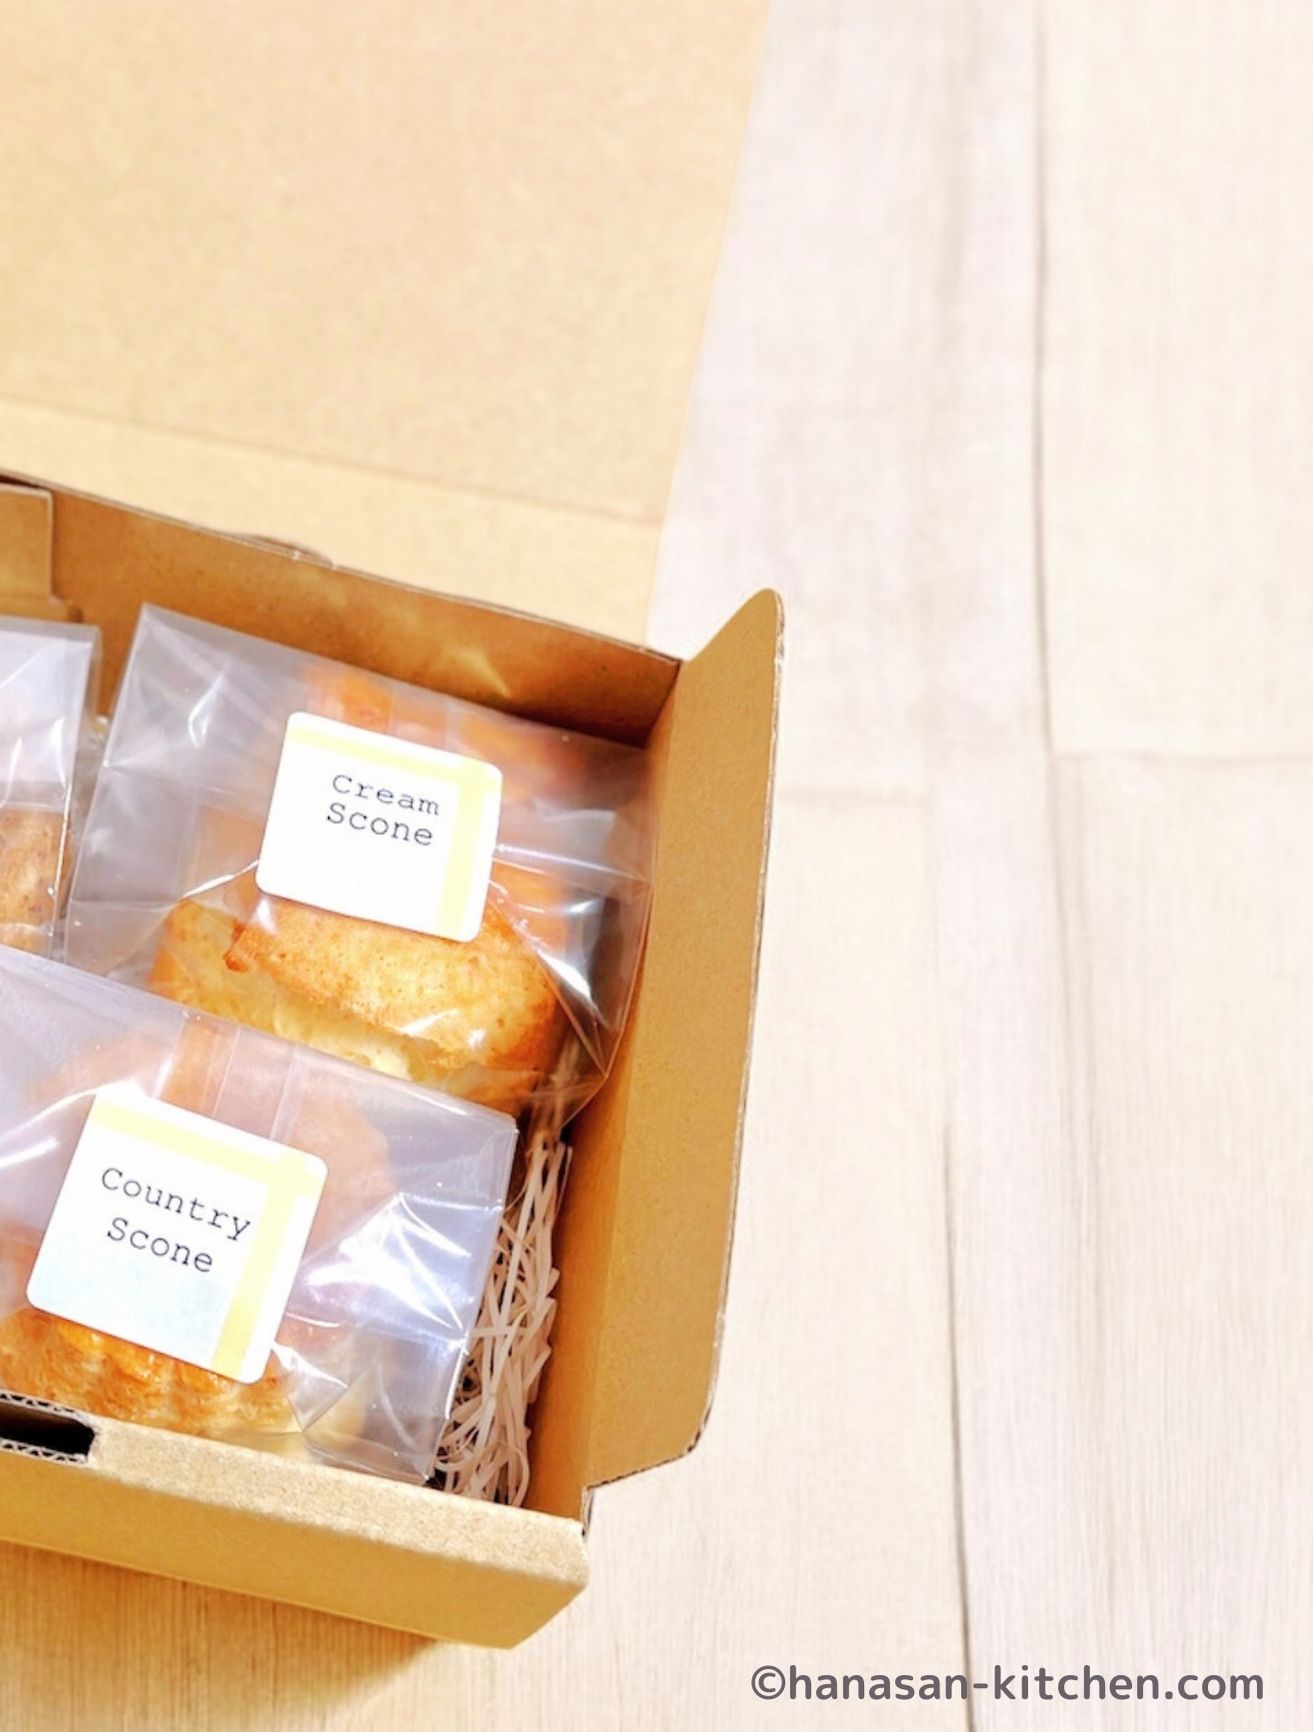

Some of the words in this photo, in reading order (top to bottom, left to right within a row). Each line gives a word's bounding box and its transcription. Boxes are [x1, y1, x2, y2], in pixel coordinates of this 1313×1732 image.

[332, 774, 440, 816] Cream
[326, 802, 433, 846] Scone
[101, 1168, 251, 1241] Country
[107, 1217, 213, 1273] Scone
